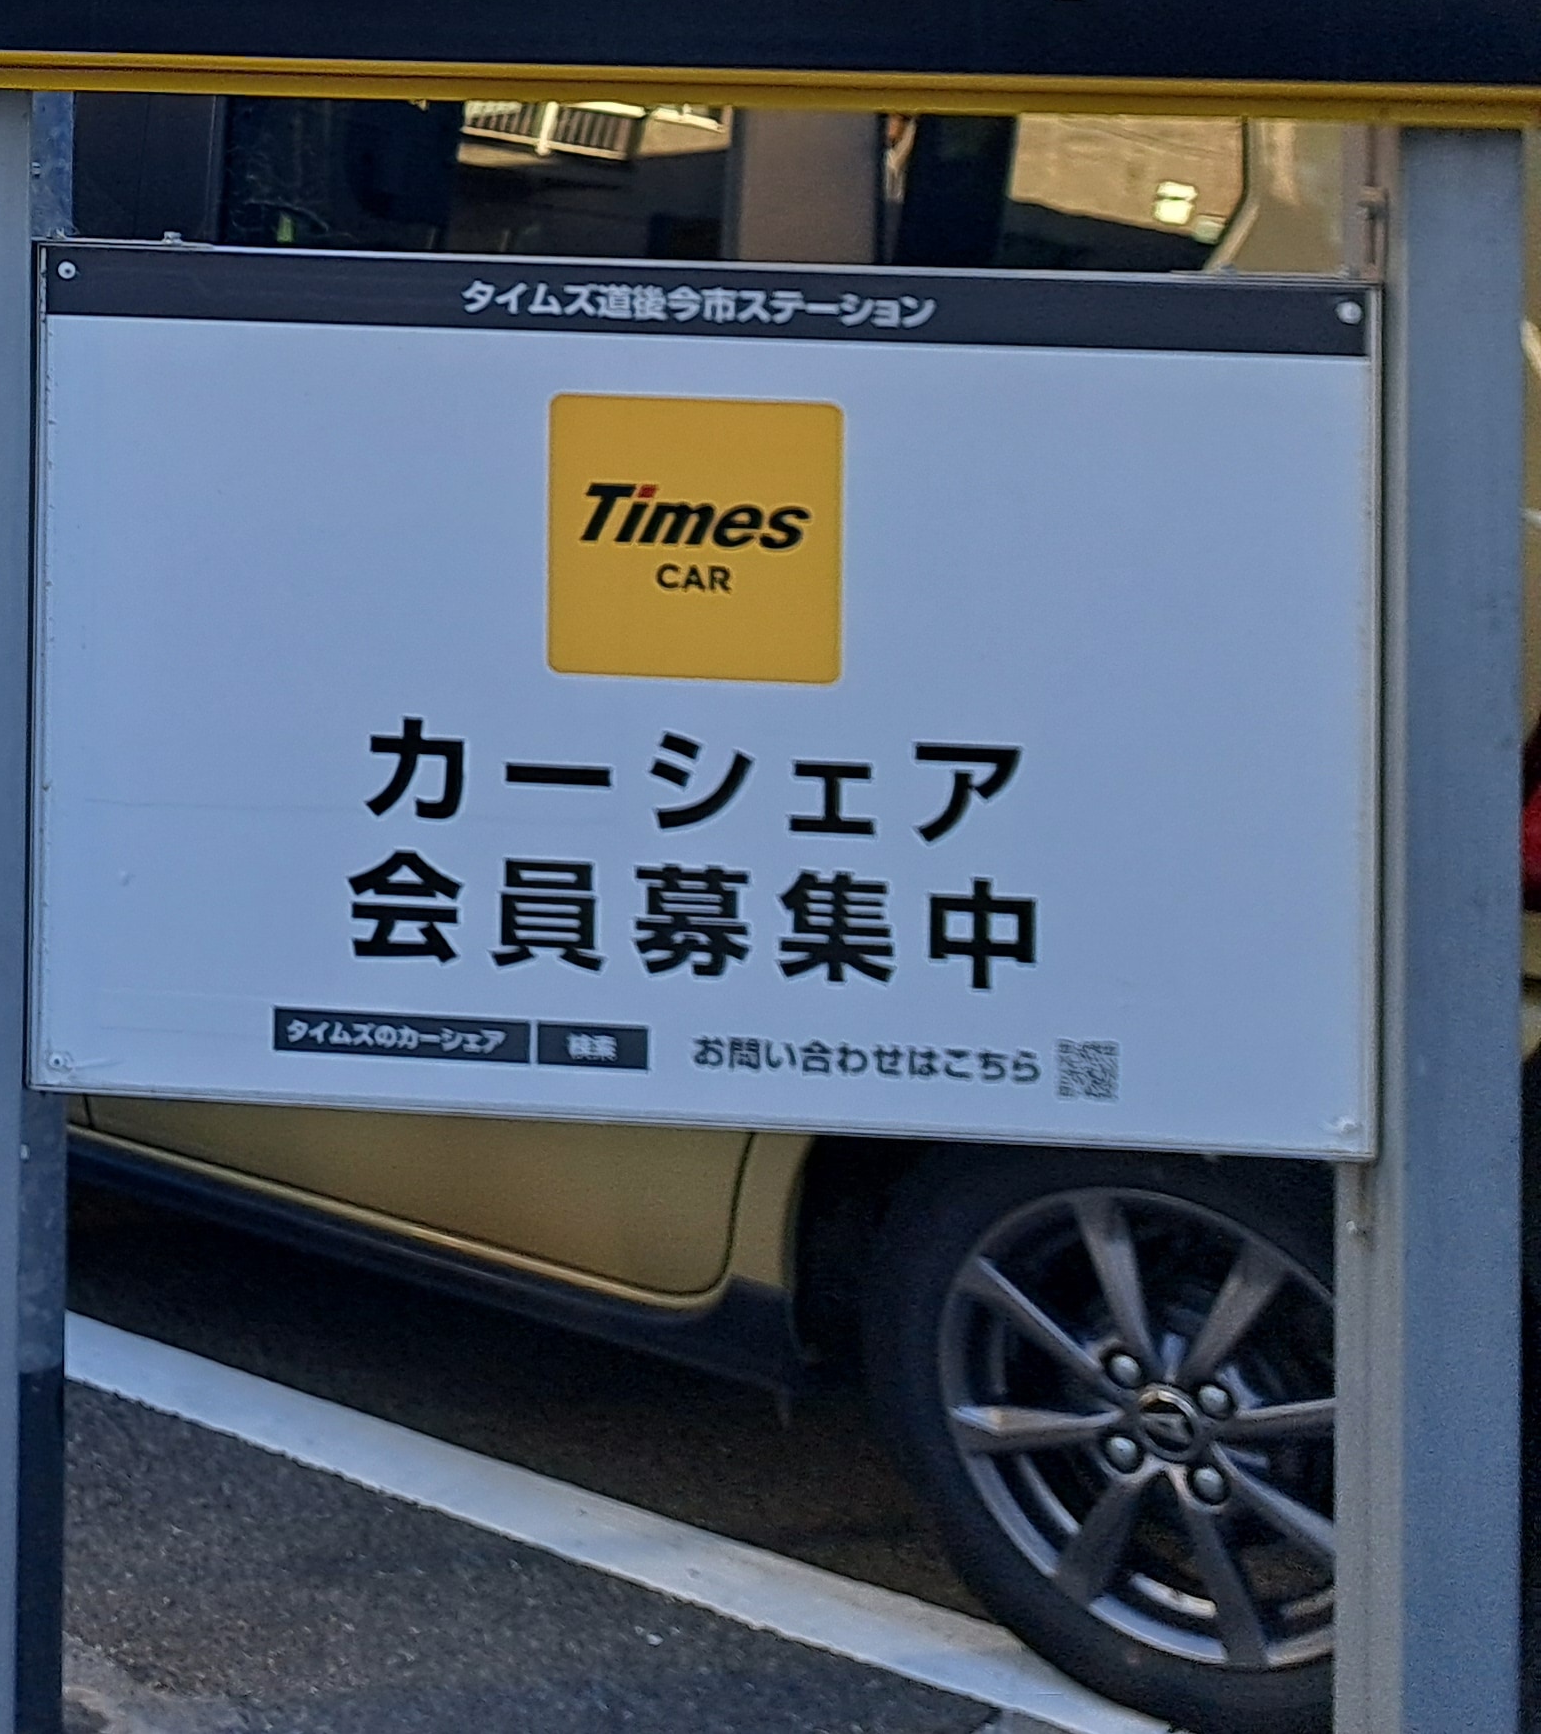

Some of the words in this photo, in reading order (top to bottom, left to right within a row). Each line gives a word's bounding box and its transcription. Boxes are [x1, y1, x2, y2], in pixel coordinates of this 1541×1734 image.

[461, 279, 938, 330] タイムズ道後今市ステーション
[578, 482, 813, 551] Times
[655, 562, 733, 595] CAR
[364, 715, 1023, 843] カーシェア
[345, 847, 1040, 992] 会員募集中
[284, 1016, 509, 1056] タイムズのカーシェア
[565, 1030, 620, 1063] 検索
[691, 1034, 1043, 1085] お問い合わせはこちら
